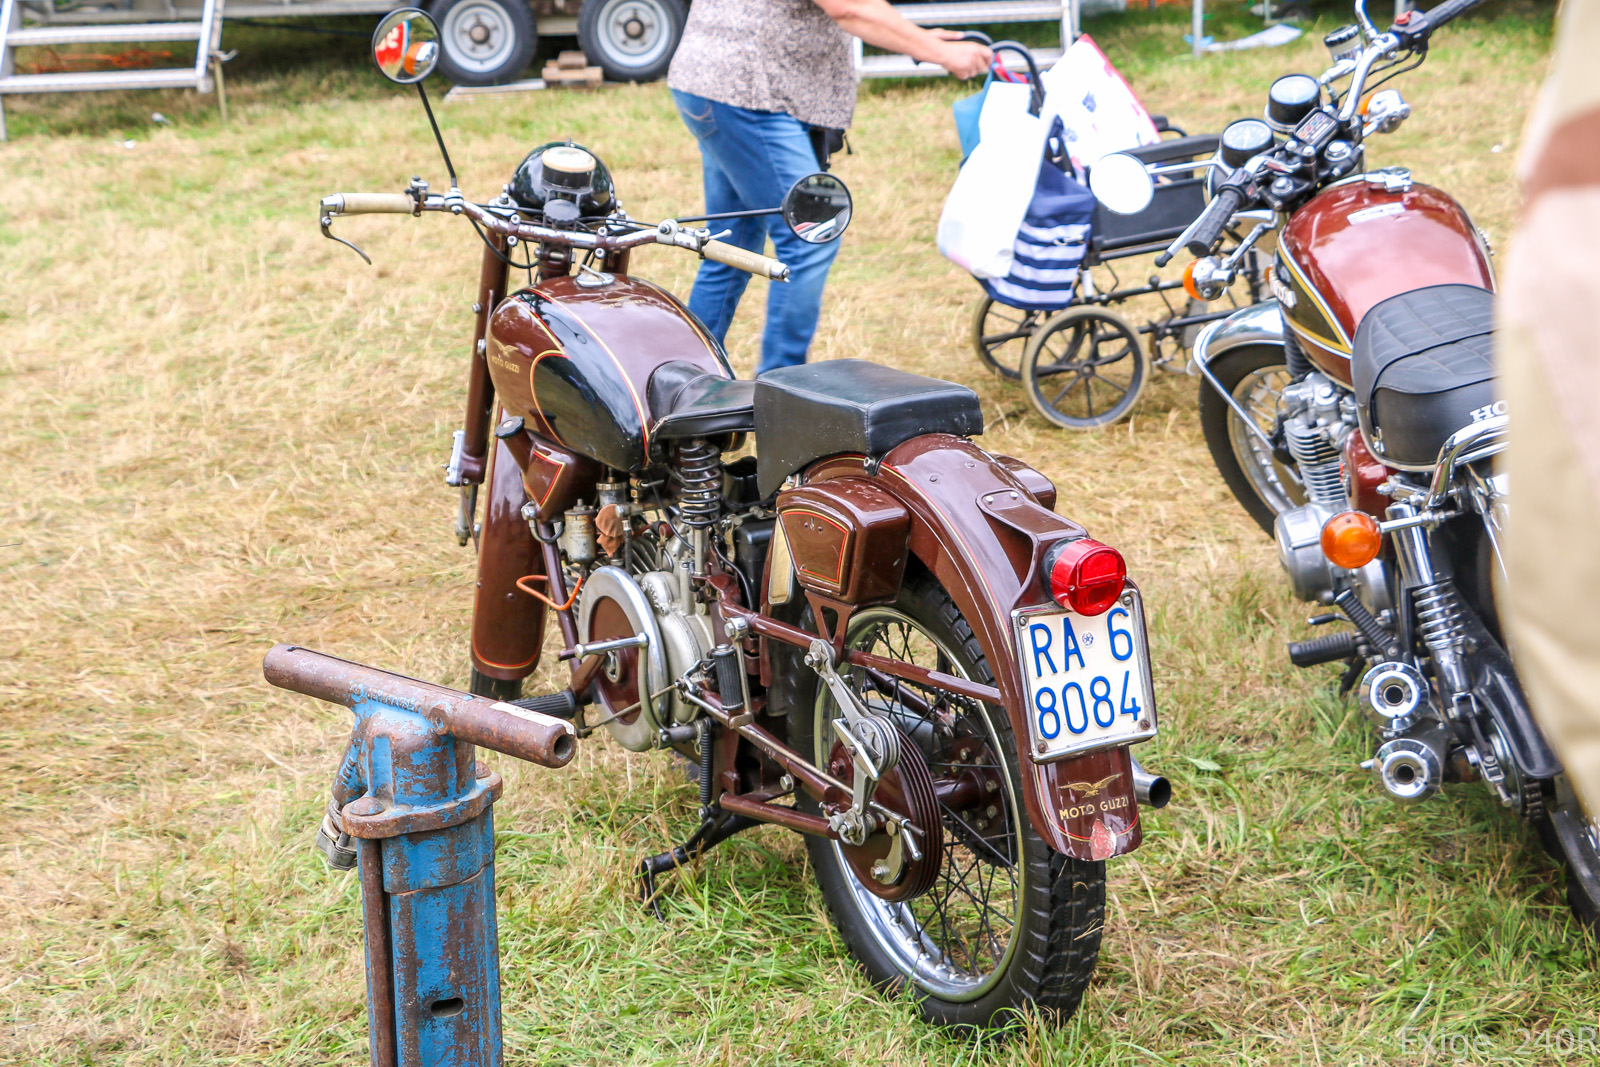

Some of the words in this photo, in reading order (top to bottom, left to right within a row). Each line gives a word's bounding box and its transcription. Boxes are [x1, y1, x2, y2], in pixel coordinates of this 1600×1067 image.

[491, 355, 504, 367] MOTO
[504, 361, 520, 374] GUZZI
[1029, 616, 1085, 678] RA
[1107, 607, 1133, 661] 6
[1035, 670, 1141, 739] 8084
[1059, 803, 1095, 820] MOTO
[1100, 796, 1129, 811] GUZZI
